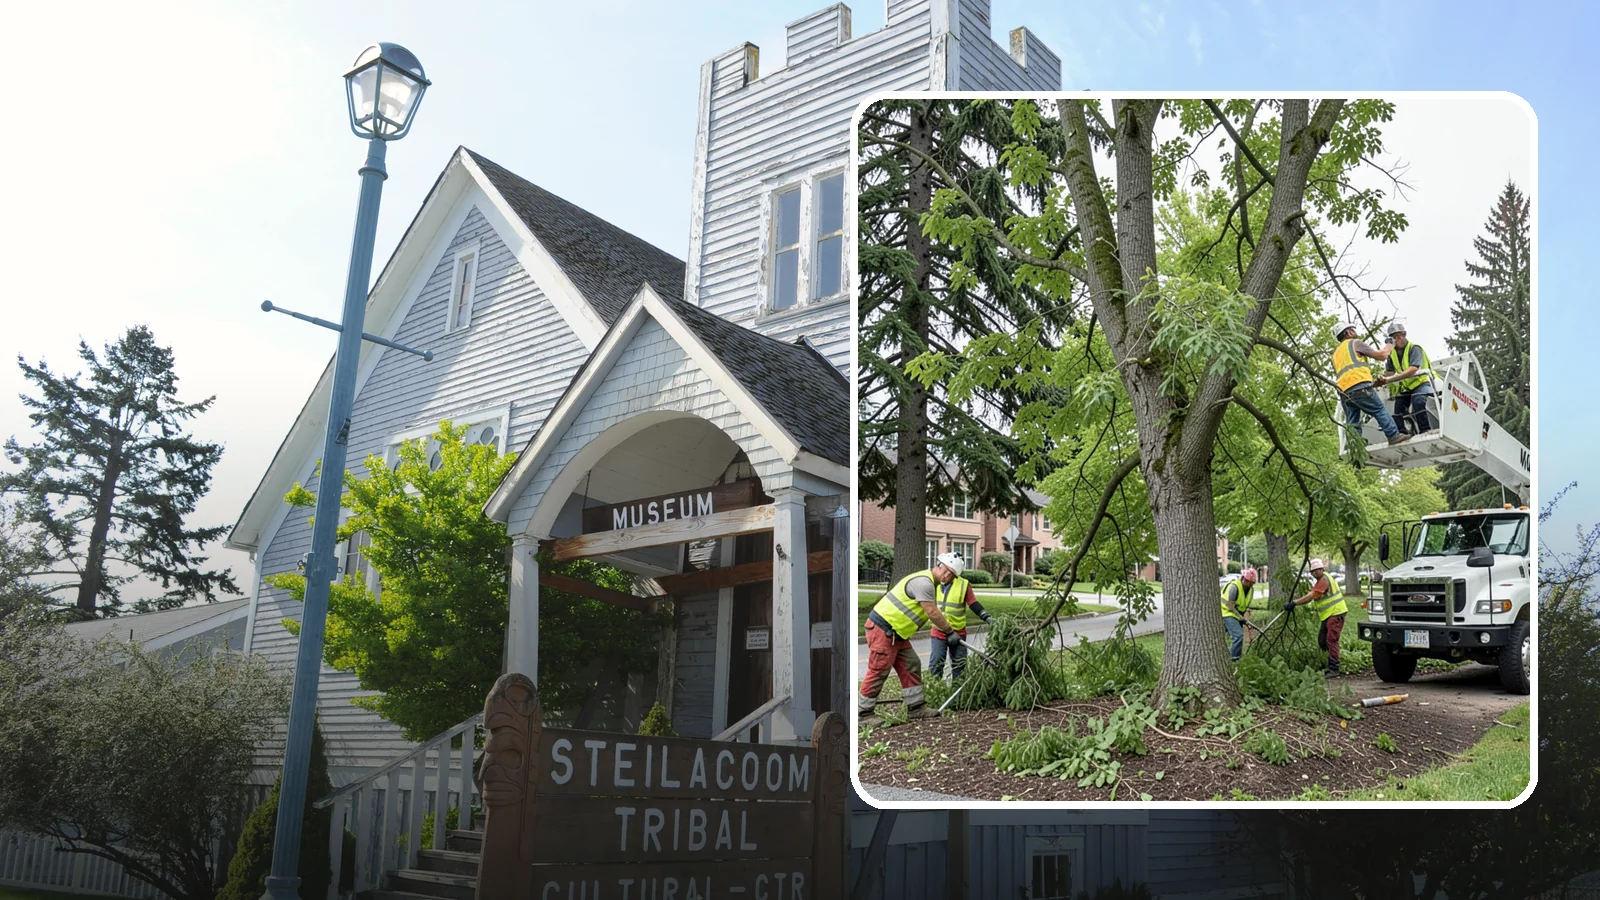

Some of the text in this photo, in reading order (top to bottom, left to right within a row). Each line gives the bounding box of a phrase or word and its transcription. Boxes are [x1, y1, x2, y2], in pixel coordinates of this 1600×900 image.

[612, 491, 713, 531] MUSEUM
[550, 738, 809, 792] STEILACOOM
[615, 806, 758, 852] TRIBAL
